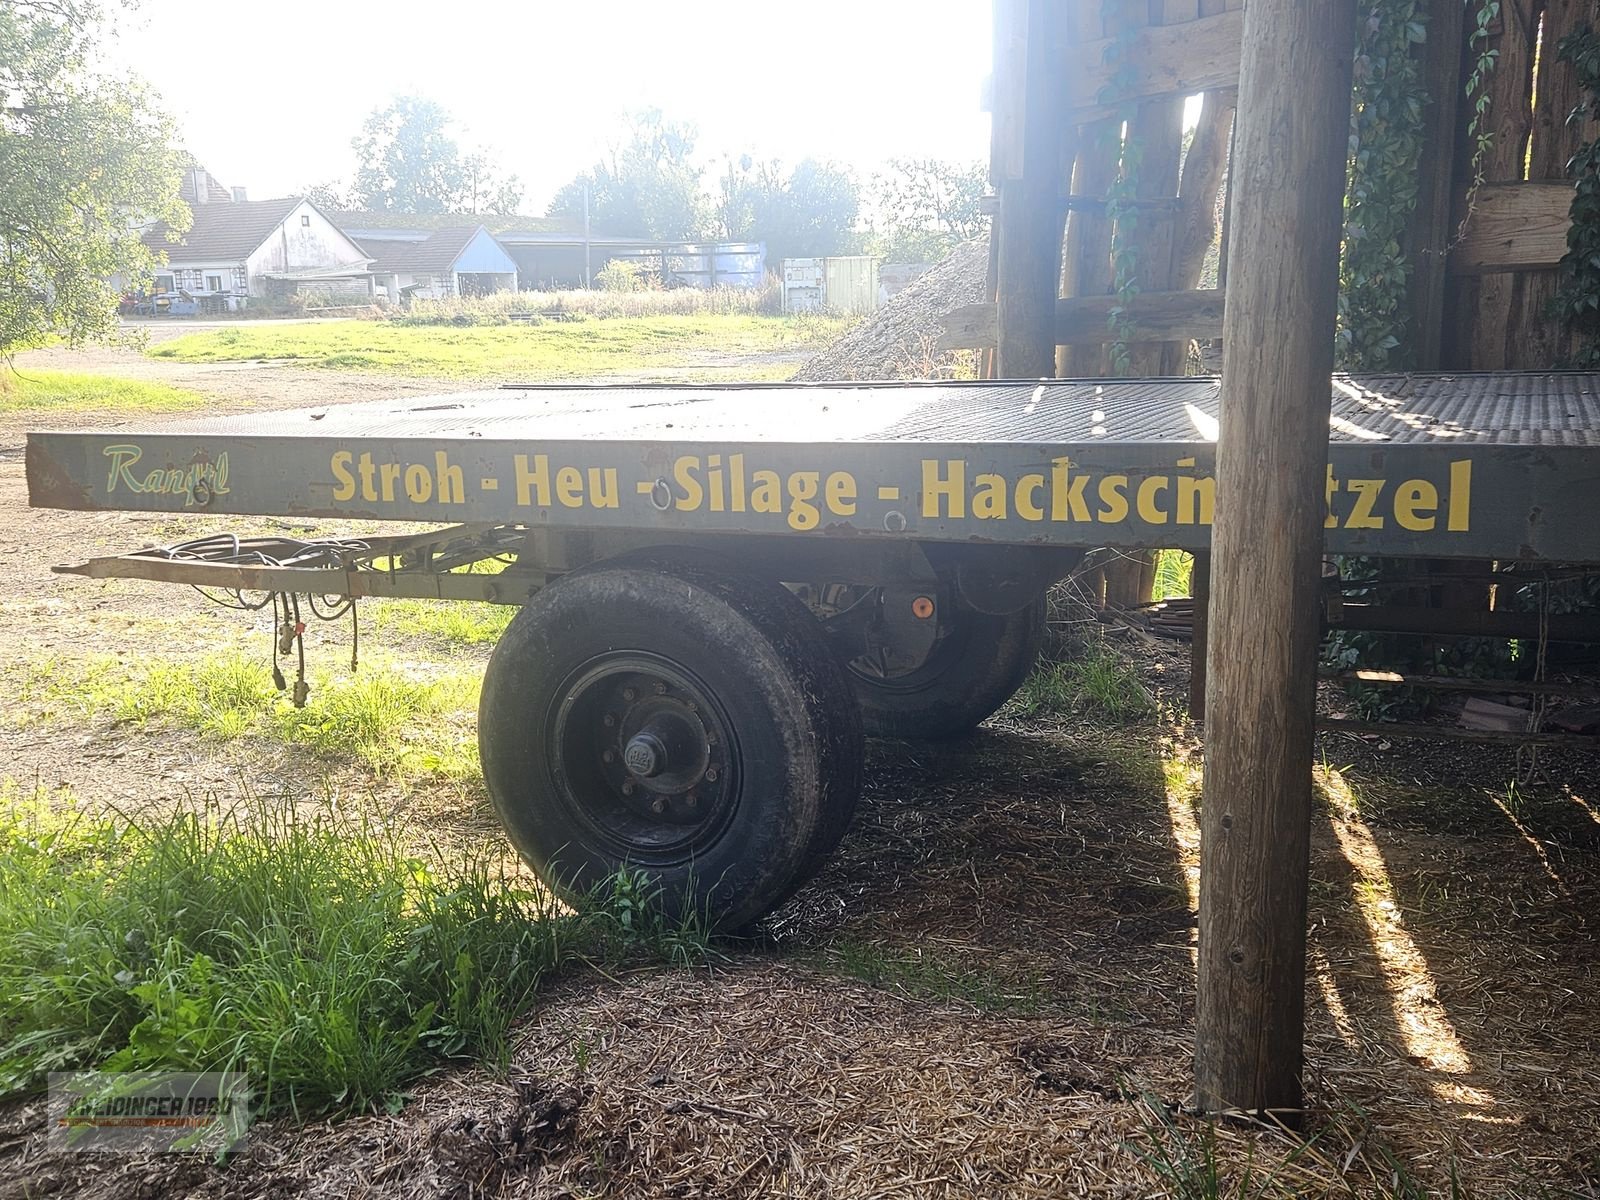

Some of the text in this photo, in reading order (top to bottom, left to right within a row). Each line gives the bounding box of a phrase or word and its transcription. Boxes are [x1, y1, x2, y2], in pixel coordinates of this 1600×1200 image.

[332, 452, 465, 506] Stroh
[481, 479, 497, 489] -
[517, 455, 617, 508] Heu
[673, 455, 857, 530] Silage
[879, 488, 898, 498] -
